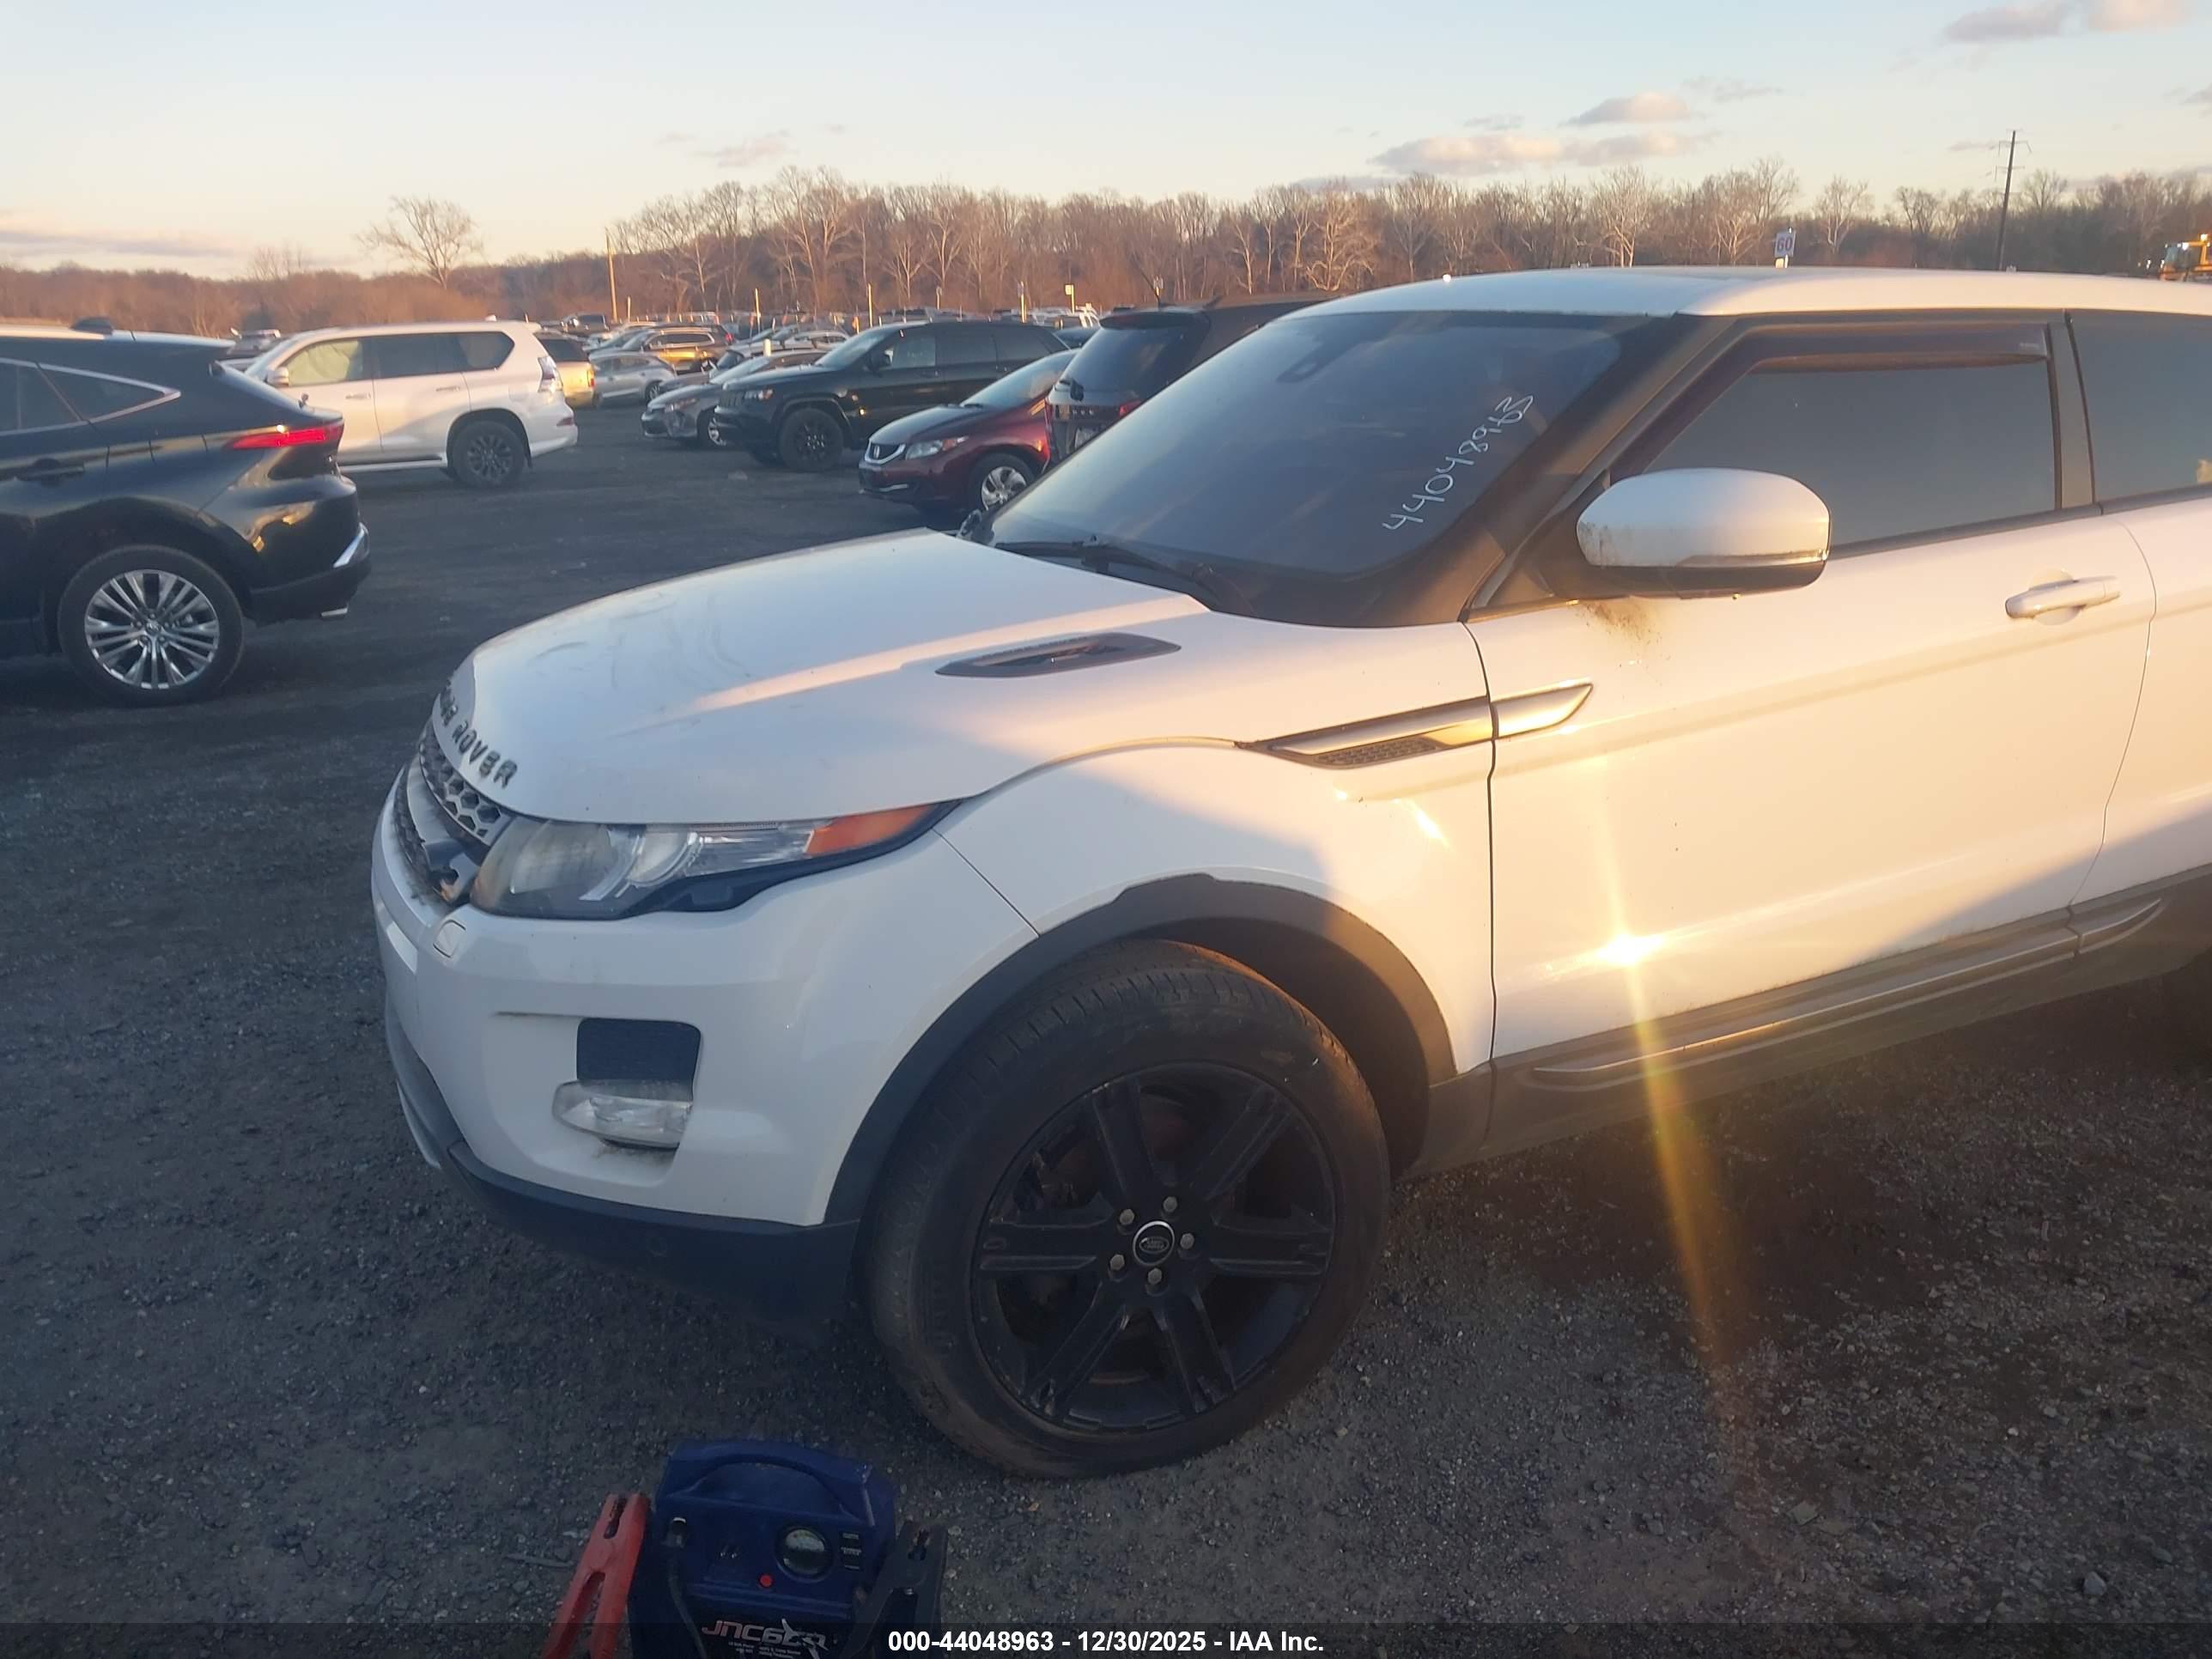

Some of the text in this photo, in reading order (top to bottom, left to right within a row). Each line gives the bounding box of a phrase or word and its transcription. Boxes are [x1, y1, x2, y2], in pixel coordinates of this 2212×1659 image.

[1776, 236, 1793, 252] 60
[1382, 395, 1534, 531] 44048963
[452, 720, 519, 789] ROVER
